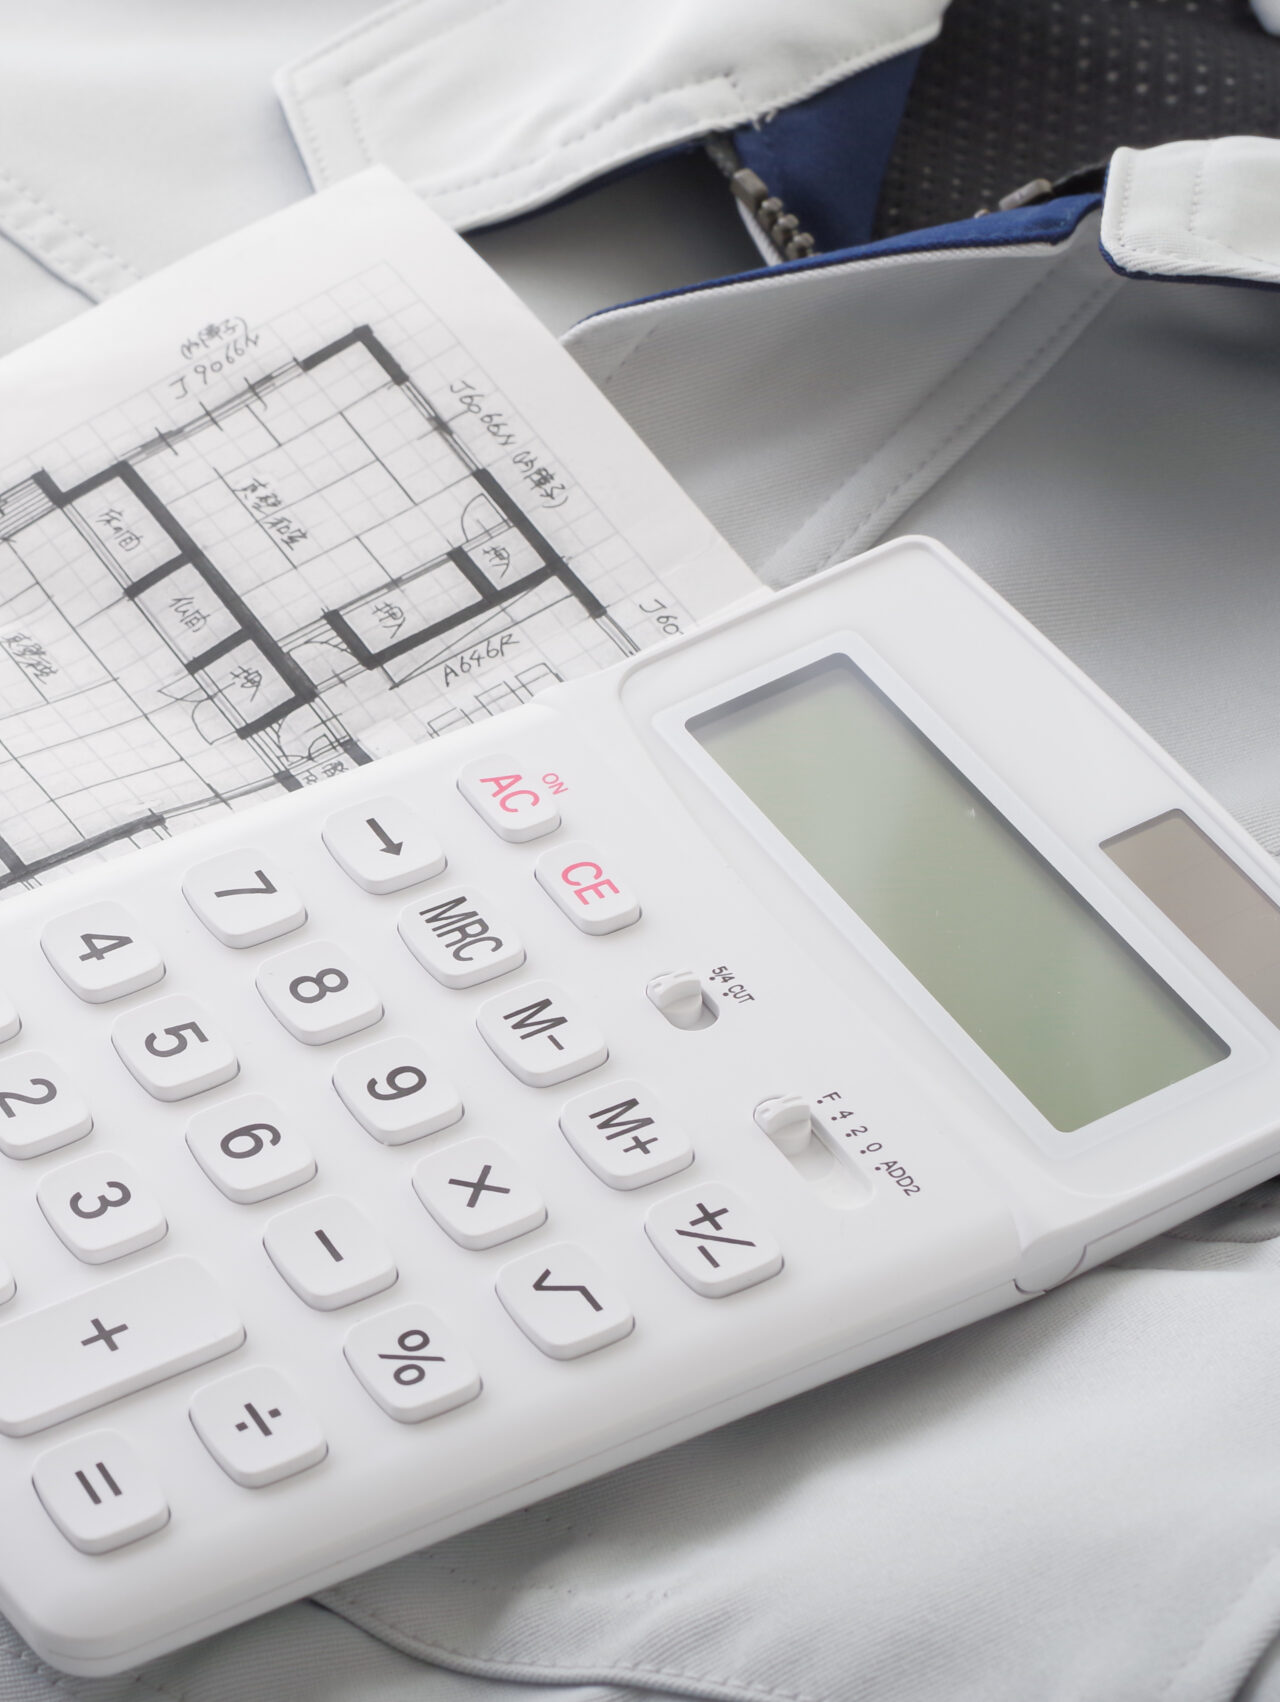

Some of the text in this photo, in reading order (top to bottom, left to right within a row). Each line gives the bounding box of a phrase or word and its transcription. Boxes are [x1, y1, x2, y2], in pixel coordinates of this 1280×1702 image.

[480, 773, 539, 814] AC
[541, 772, 568, 795] ON
[215, 870, 277, 897] 7
[561, 861, 619, 905] CE
[79, 934, 133, 961] 4
[419, 896, 503, 962] MRC
[289, 968, 348, 1003] 8
[710, 965, 755, 1005] 5/4 CUT
[145, 1022, 208, 1057] 5
[503, 999, 568, 1051] M-
[367, 1066, 426, 1100] 9
[221, 1124, 281, 1158] 6
[589, 1097, 659, 1155] M+
[822, 1091, 922, 1197] F 4 2 0 ADD2
[70, 1181, 131, 1219] 3
[378, 1329, 446, 1386] %
